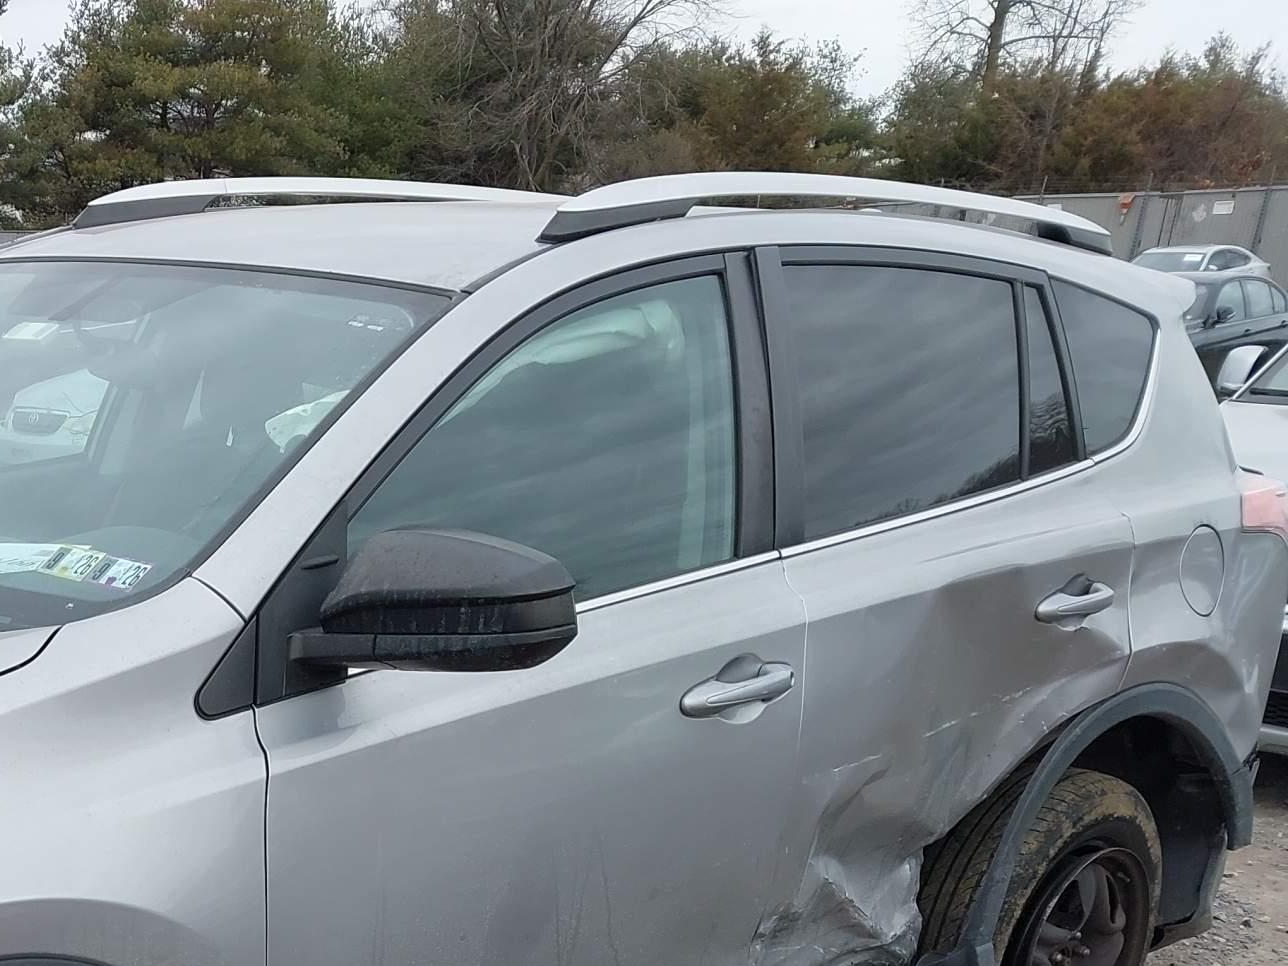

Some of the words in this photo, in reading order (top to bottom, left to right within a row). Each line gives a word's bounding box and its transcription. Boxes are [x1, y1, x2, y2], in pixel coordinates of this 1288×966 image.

[45, 551, 65, 570] 9
[92, 562, 111, 581] 9
[121, 565, 148, 587] 26
